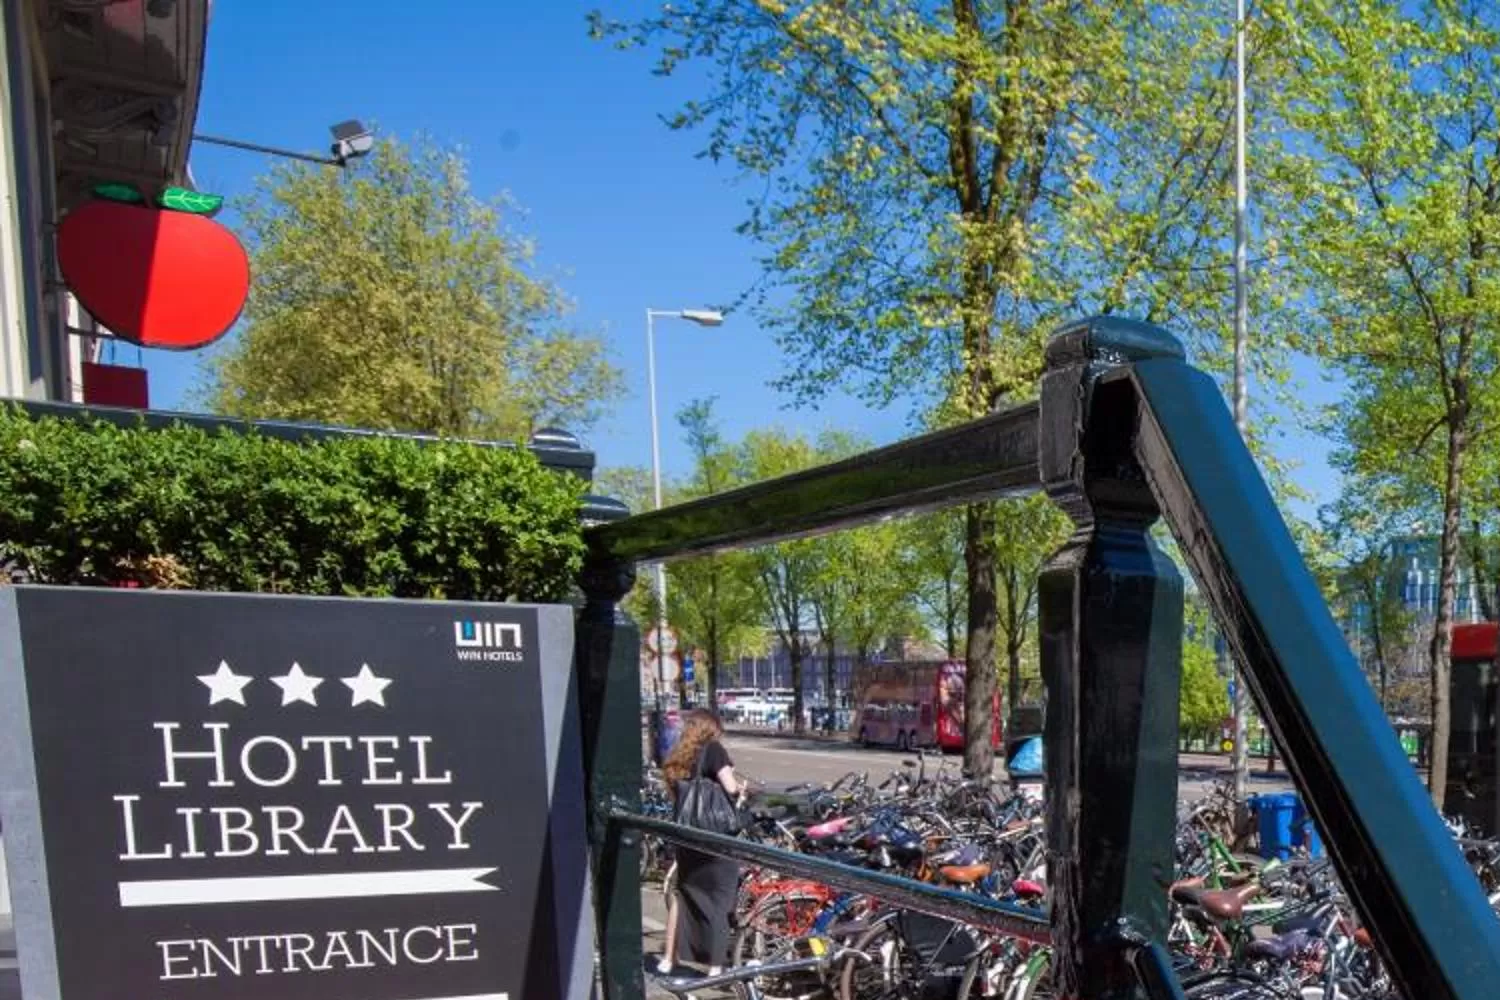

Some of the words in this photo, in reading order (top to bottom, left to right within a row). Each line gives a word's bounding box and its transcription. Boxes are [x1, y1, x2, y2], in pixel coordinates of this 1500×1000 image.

[457, 651, 481, 661] WIN
[483, 651, 524, 662] HOTELS
[153, 721, 453, 788] HOTEL
[113, 794, 484, 861] LIBRARY
[156, 923, 480, 981] ENTRANCE
